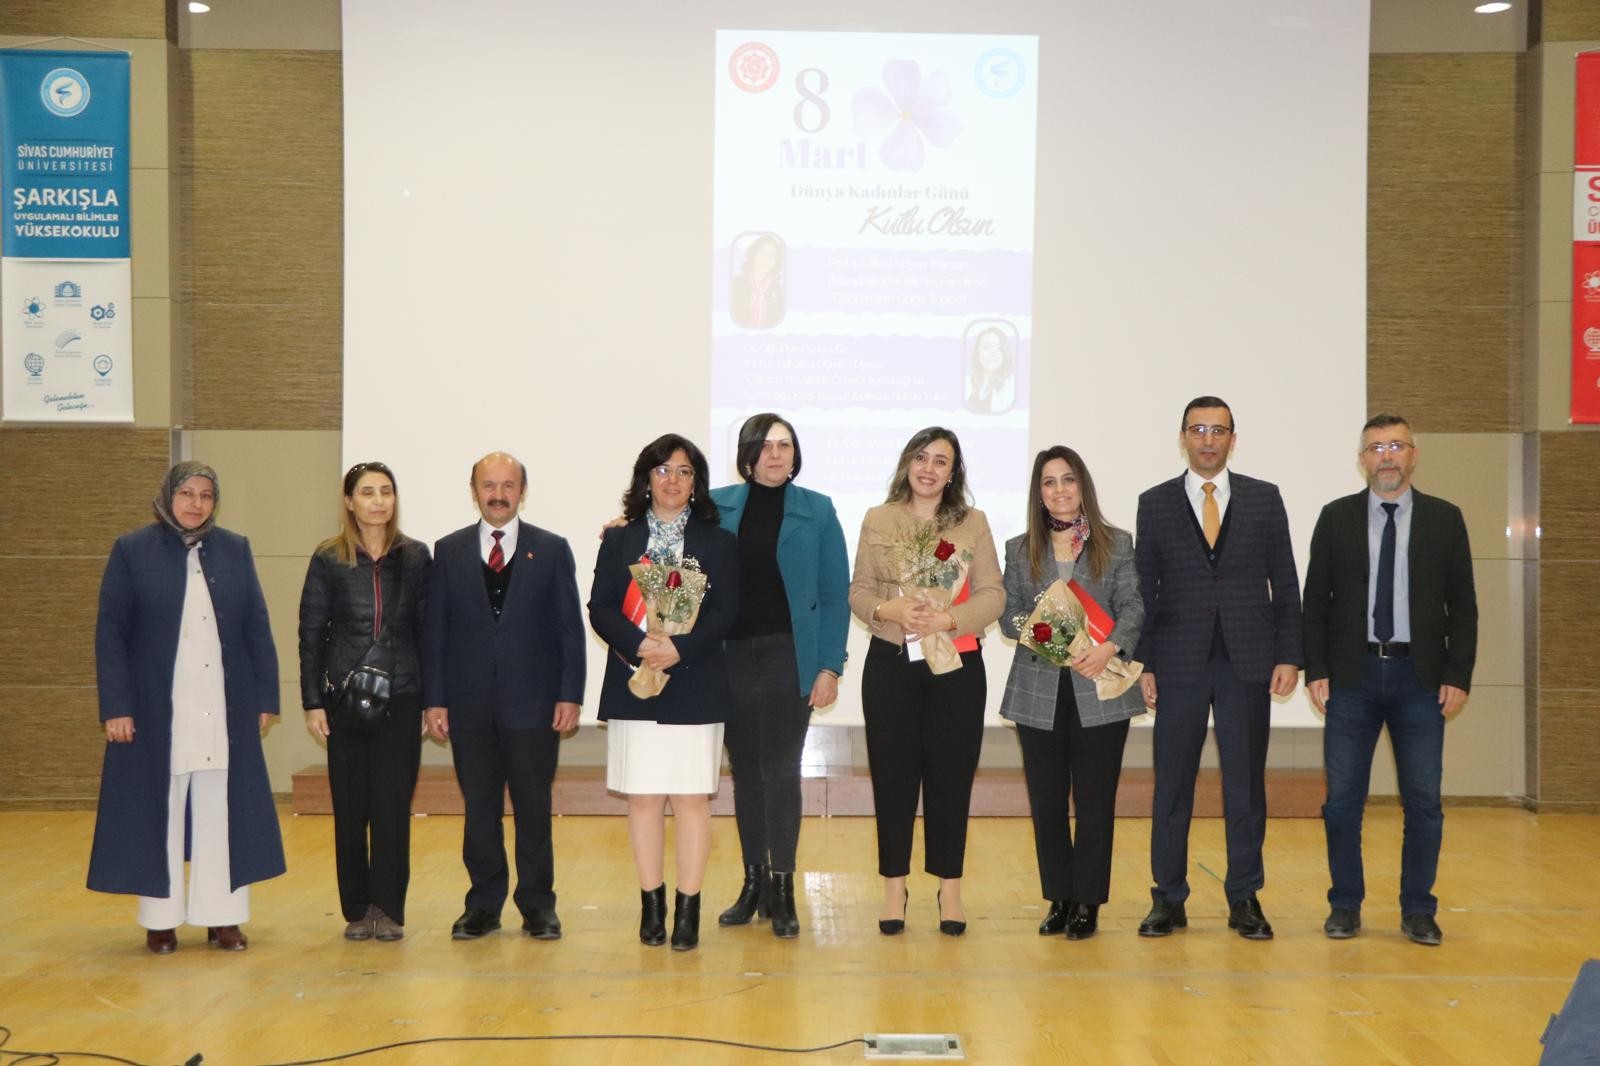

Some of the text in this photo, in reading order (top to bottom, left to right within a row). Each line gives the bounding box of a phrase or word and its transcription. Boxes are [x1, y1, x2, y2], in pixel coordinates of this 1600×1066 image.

[793, 67, 831, 134] 8
[18, 143, 114, 159] SİVAS CUMHURİYET
[779, 138, 868, 170] Mart
[18, 159, 113, 171] ÜNİVERSİTESİ
[14, 188, 119, 210] ŞARKIŞLA
[791, 184, 970, 201] Dünya Kadınlar Günü
[14, 212, 119, 222] UYGULAMALI BİLİMLER
[857, 205, 994, 236] Kutlu Olsun
[15, 222, 120, 238] YÜKSEKOKULU
